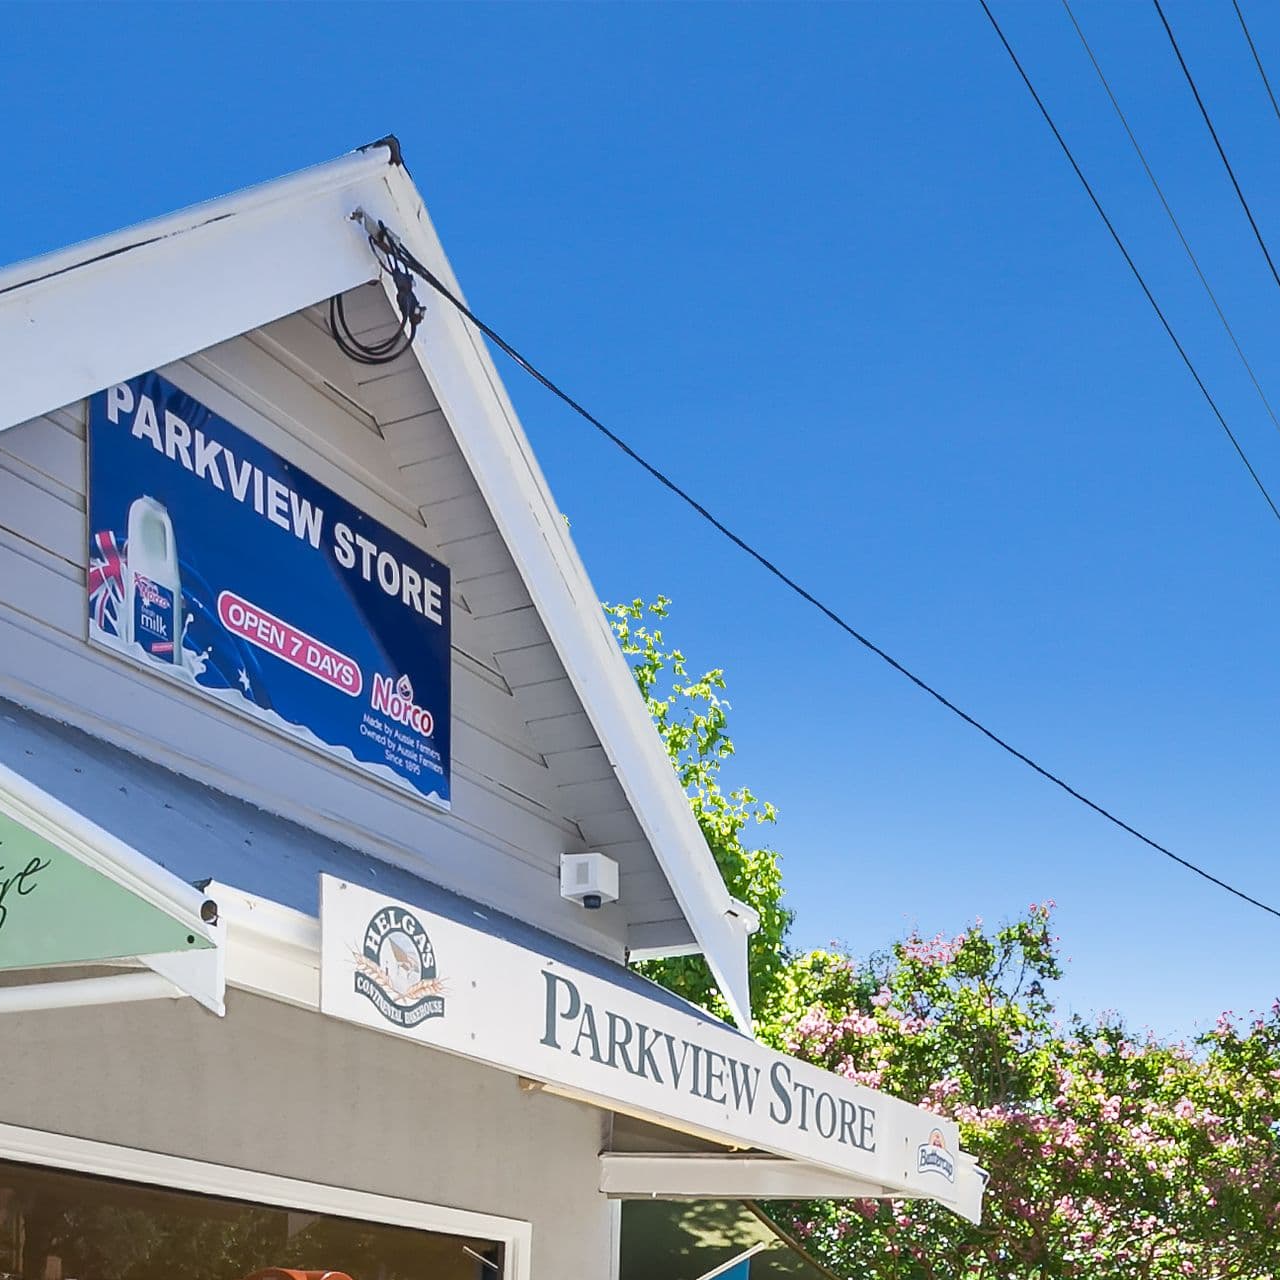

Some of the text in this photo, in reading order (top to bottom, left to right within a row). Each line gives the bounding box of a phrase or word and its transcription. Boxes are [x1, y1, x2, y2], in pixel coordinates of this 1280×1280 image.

[107, 382, 443, 626] PARKVIEW STORE
[141, 614, 167, 637] milk
[229, 603, 355, 689] OPEN 7 DAYS
[371, 673, 434, 738] Norco
[360, 724, 444, 775] Owned by Aussie Farmers
[363, 713, 441, 761] Made by Aussie Farmers
[384, 749, 403, 766] Since
[365, 910, 434, 968] HELGA'S
[540, 969, 876, 1154] PARKVIEW STORE
